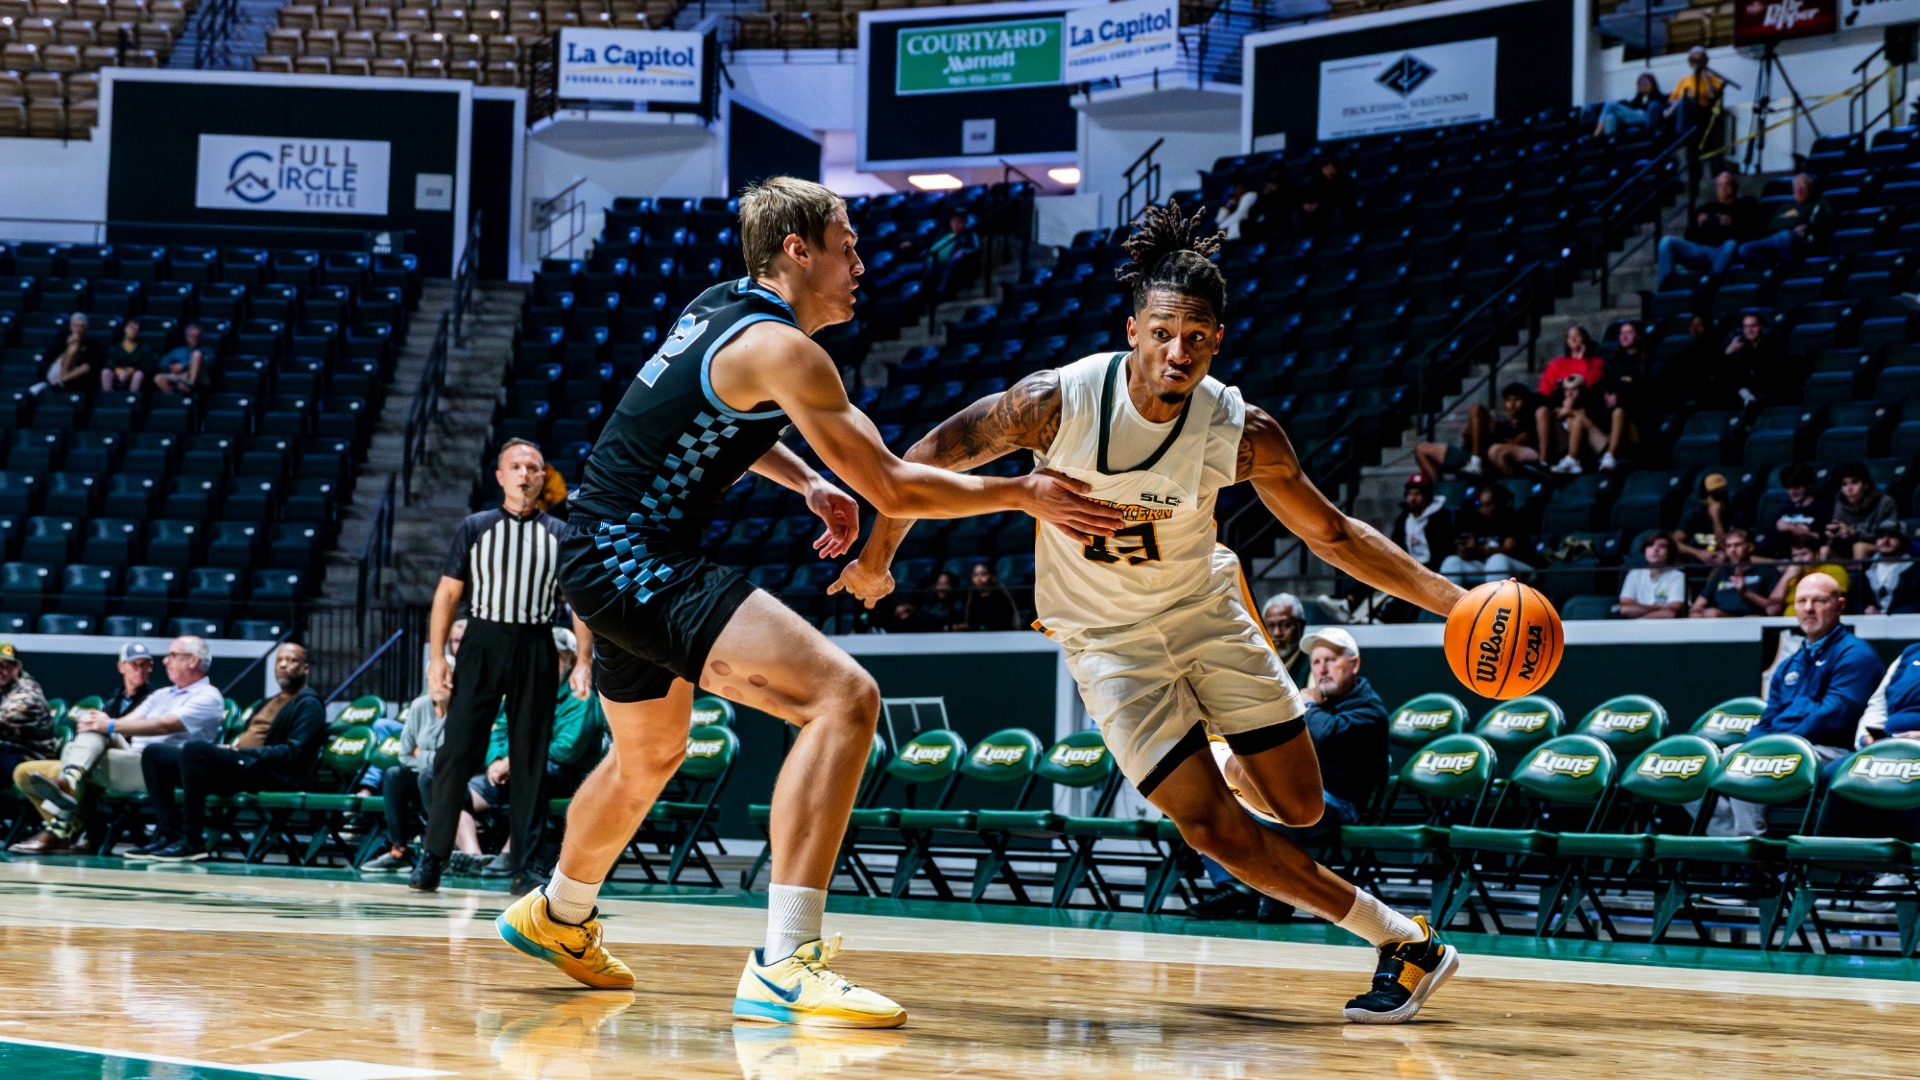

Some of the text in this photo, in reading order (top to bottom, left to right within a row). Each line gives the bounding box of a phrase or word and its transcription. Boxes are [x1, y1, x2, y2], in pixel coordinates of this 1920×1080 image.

[1070, 7, 1172, 47] La Capitol
[907, 27, 1047, 55] COURTYARD
[567, 43, 695, 71] La Capitol
[942, 50, 1016, 75] Marriott
[565, 75, 695, 87] FEDERAL CREDIT UNION
[279, 144, 358, 167] FULL
[304, 193, 357, 208] TITLE
[1140, 491, 1180, 508] SLC
[1476, 607, 1513, 683] Wilson
[1518, 625, 1544, 681] NCAA
[1395, 710, 1451, 728] Lions
[1492, 711, 1549, 730] Lions
[1594, 711, 1651, 731] Lions
[903, 743, 950, 763] Lions
[973, 744, 1025, 764] Lions
[1051, 745, 1103, 764] Lions
[1415, 751, 1476, 772] Lions
[1533, 751, 1597, 774] Lions
[1640, 755, 1705, 776] Lions
[1727, 754, 1801, 776] Lions
